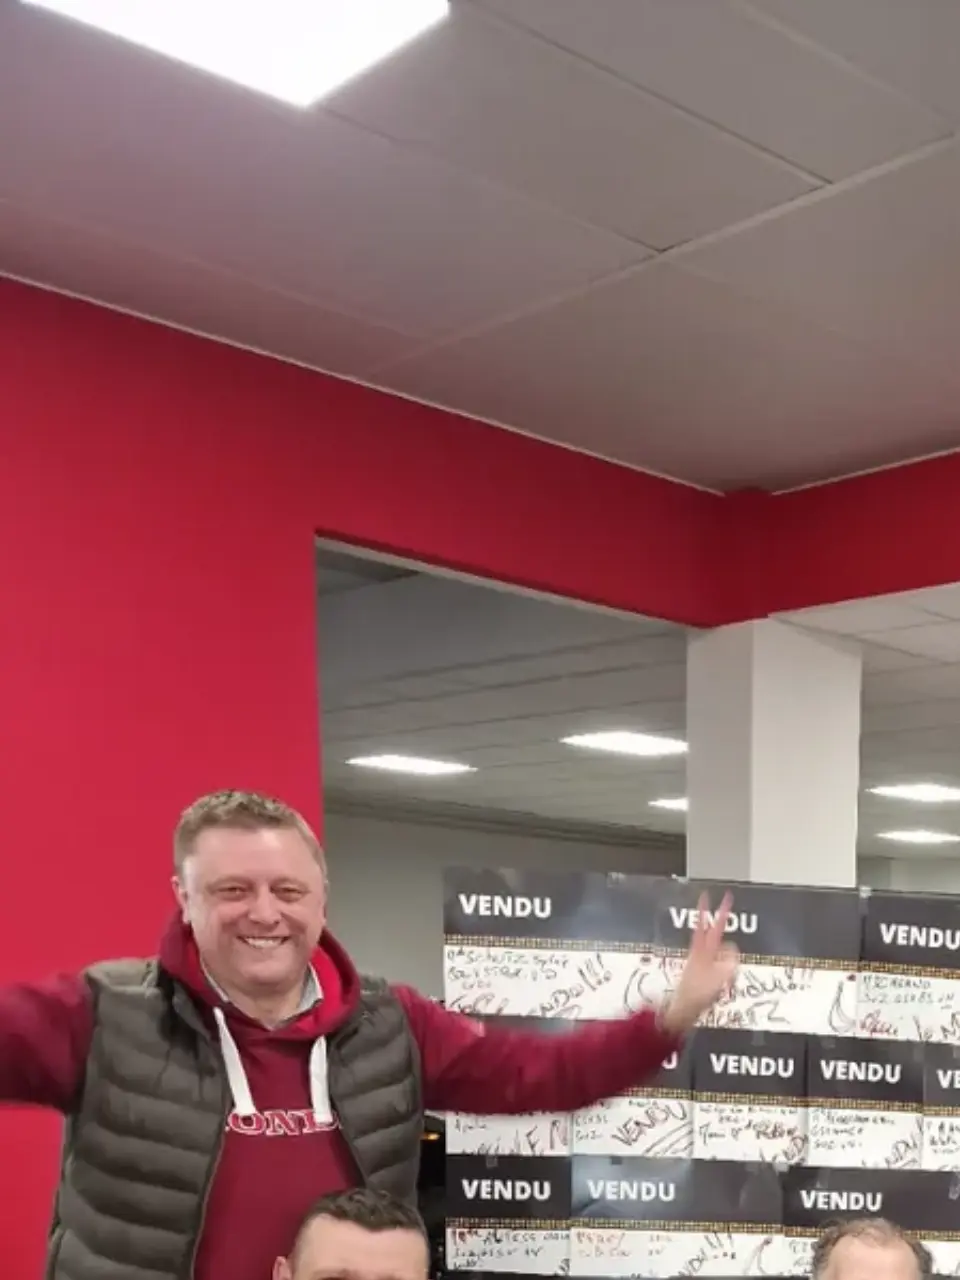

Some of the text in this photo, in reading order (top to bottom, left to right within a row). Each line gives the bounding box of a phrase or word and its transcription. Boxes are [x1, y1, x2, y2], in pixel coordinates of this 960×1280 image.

[458, 893, 553, 919] VENDU
[668, 906, 759, 934] VENDU
[709, 1053, 795, 1077] VENDU
[820, 1059, 901, 1083] VENDU
[461, 1179, 552, 1201] VENDU
[587, 1179, 676, 1202] VENDU
[800, 1189, 883, 1212] VENDU
